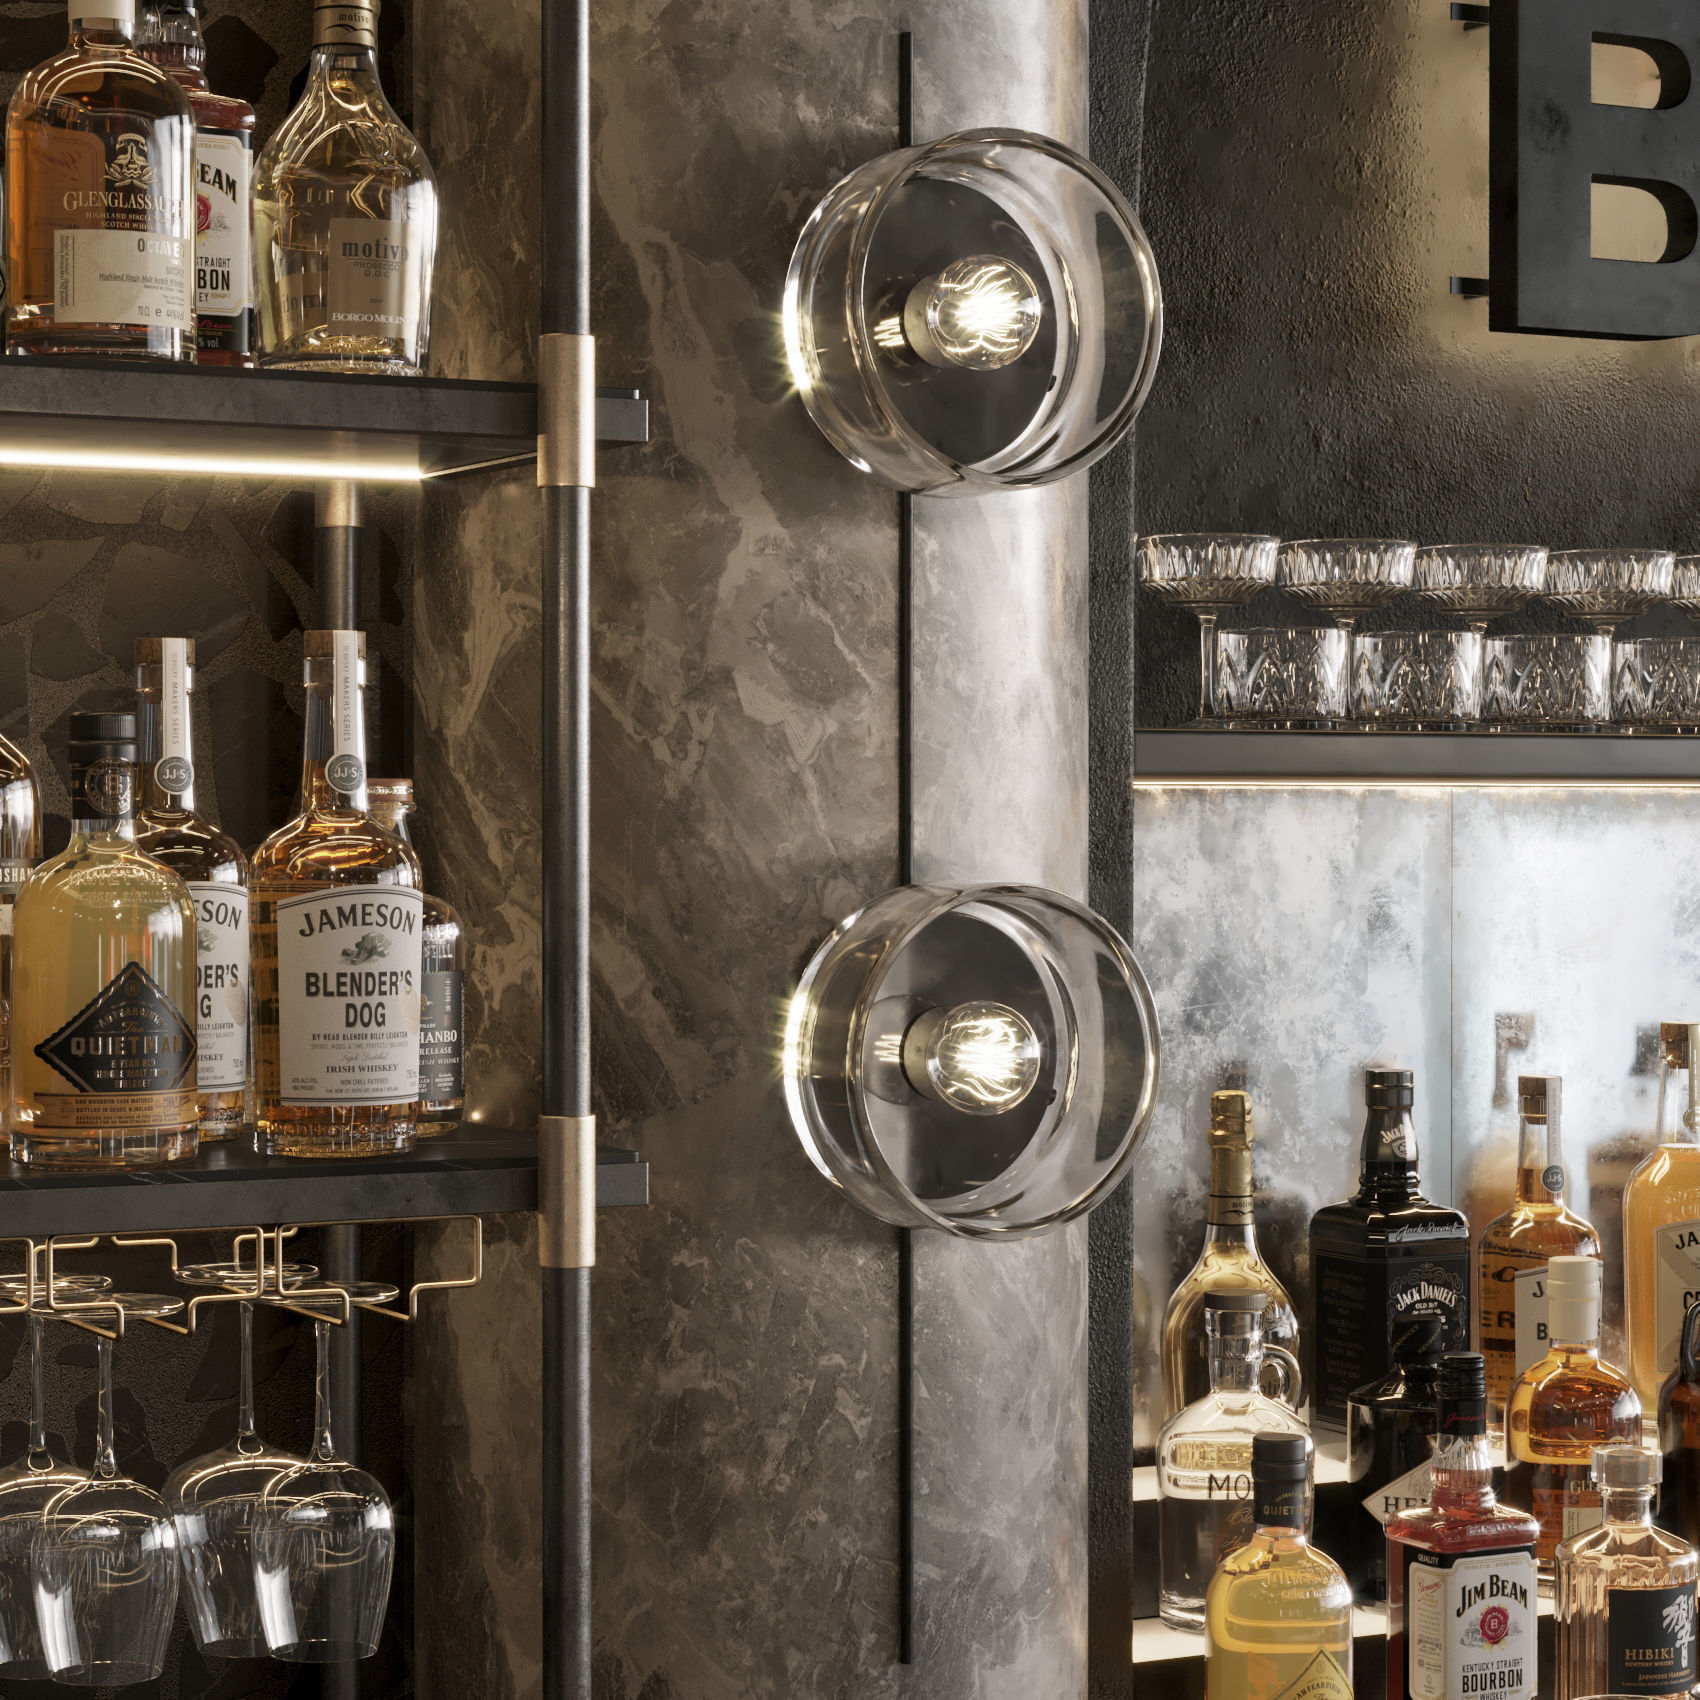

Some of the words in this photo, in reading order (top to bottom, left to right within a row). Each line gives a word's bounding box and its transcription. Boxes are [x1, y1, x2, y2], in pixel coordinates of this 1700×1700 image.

[1489, 0, 1700, 341] B
[86, 211, 127, 220] HIGHLAND
[341, 237, 409, 262] motivo
[98, 272, 125, 282] Highland
[353, 261, 400, 271] PROSECCO
[332, 312, 374, 322] BORGO
[171, 681, 179, 715] MAKERS
[172, 718, 180, 745] SERIES
[299, 903, 415, 937] JAMESON
[305, 970, 412, 997] BLENDER'S
[345, 1001, 386, 1028] DOG
[70, 1036, 140, 1057] QUIET
[143, 1034, 183, 1056] MAN
[312, 1033, 321, 1041] BY
[323, 1032, 340, 1041] HEAD
[342, 1032, 368, 1040] BLENDER
[370, 1032, 385, 1040] BILLY
[420, 1046, 453, 1056] RELEASE
[326, 1065, 355, 1073] IRISH
[358, 1064, 399, 1073] WHISKEY
[1396, 1286, 1420, 1311] JACK
[1208, 1473, 1250, 1500] MO
[1263, 1505, 1296, 1516] QUIET
[1417, 1553, 1439, 1566] QUALITY
[1456, 1582, 1486, 1618] JIM
[1489, 1574, 1528, 1610] BEAM
[1462, 1662, 1495, 1674] KENTUCKY
[1496, 1657, 1523, 1670] STRAIGHT
[1625, 1647, 1675, 1661] HIBIKI
[1462, 1668, 1523, 1693] BOURBON
